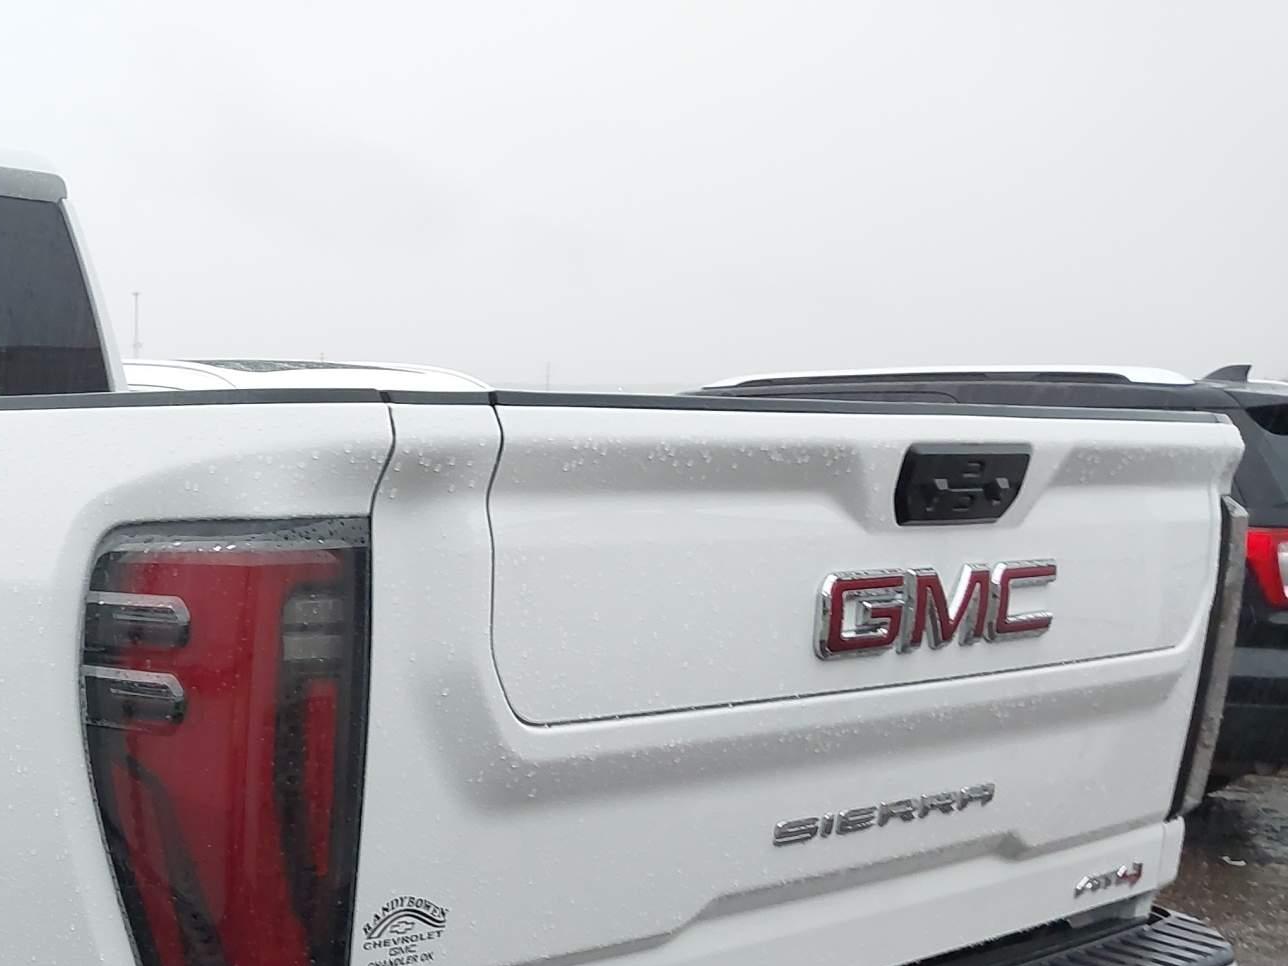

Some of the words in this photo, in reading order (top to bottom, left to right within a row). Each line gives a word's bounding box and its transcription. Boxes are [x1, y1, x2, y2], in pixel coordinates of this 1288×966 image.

[813, 558, 1057, 660] GMC
[773, 782, 996, 847] SIERRA
[363, 930, 443, 951] CHEVROLET
